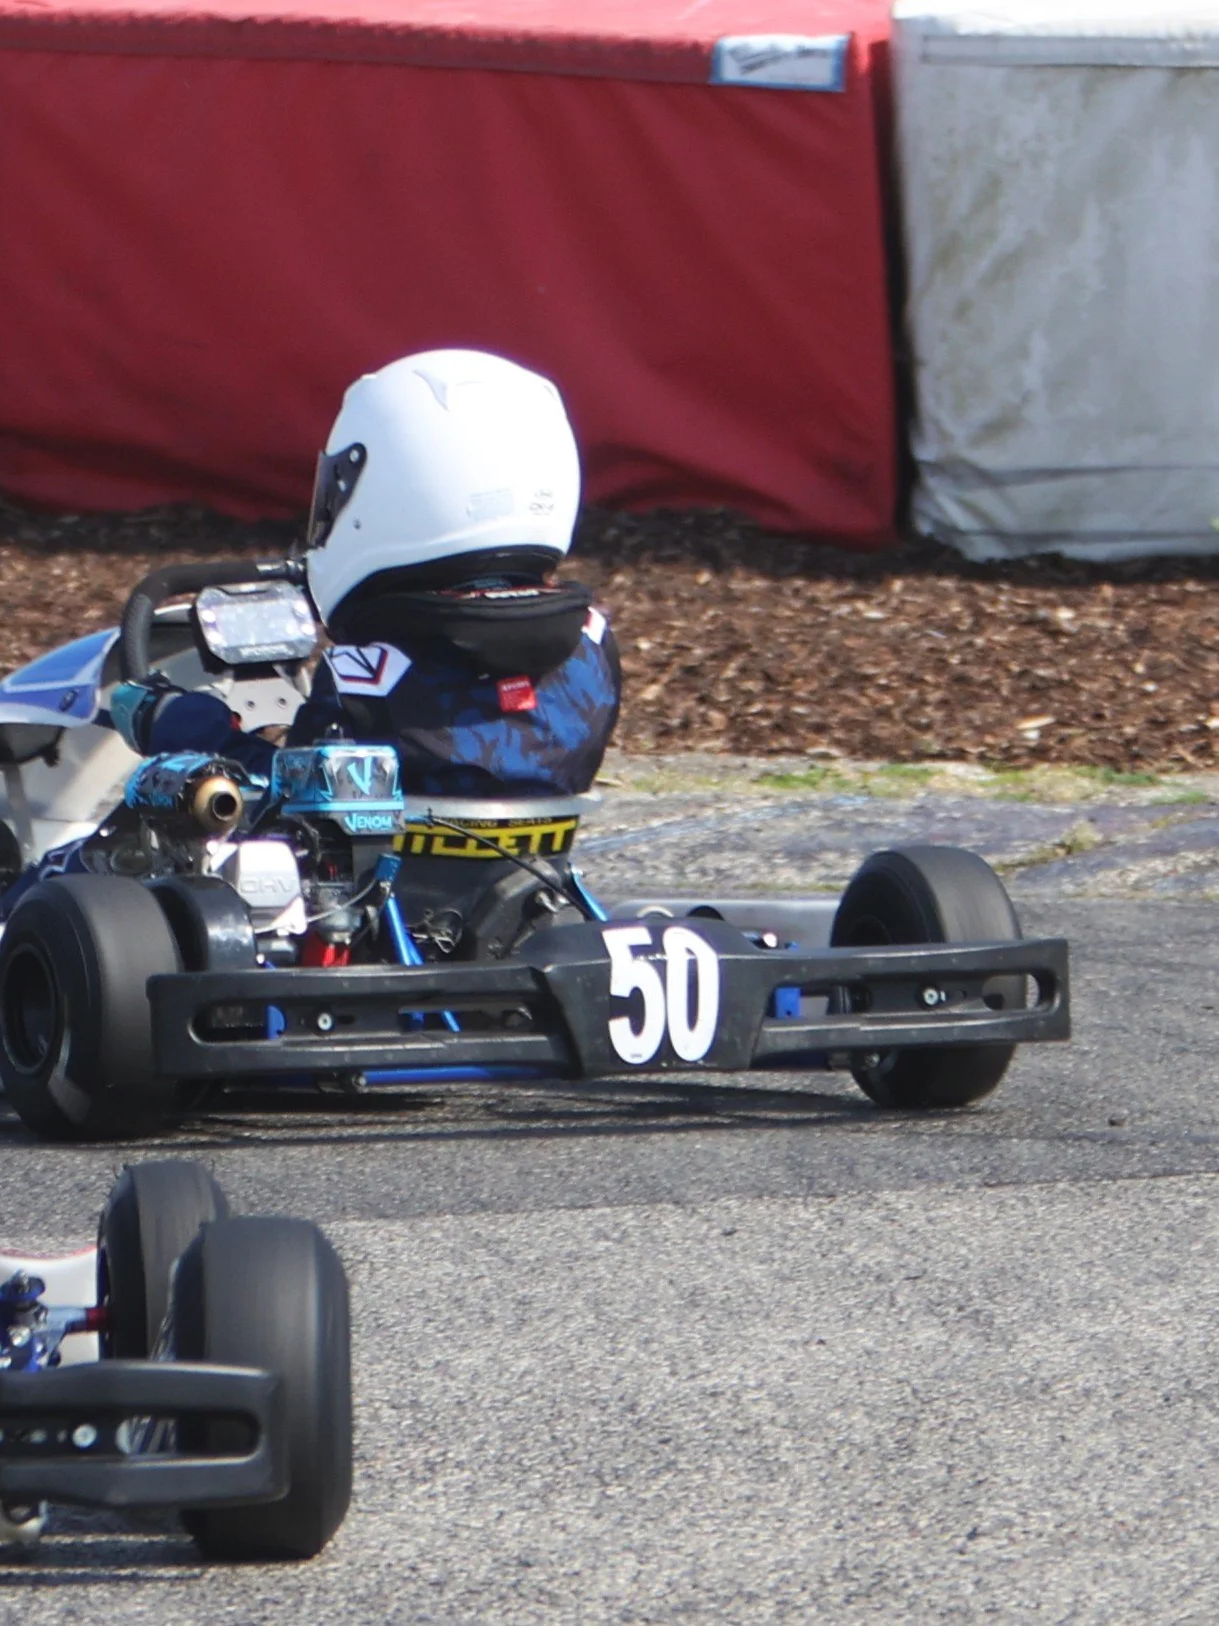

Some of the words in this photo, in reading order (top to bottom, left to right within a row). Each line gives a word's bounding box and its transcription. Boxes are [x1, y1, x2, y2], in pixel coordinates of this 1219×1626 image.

[344, 813, 392, 832] VENOM
[240, 876, 297, 894] OHV
[601, 926, 719, 1064] 50
